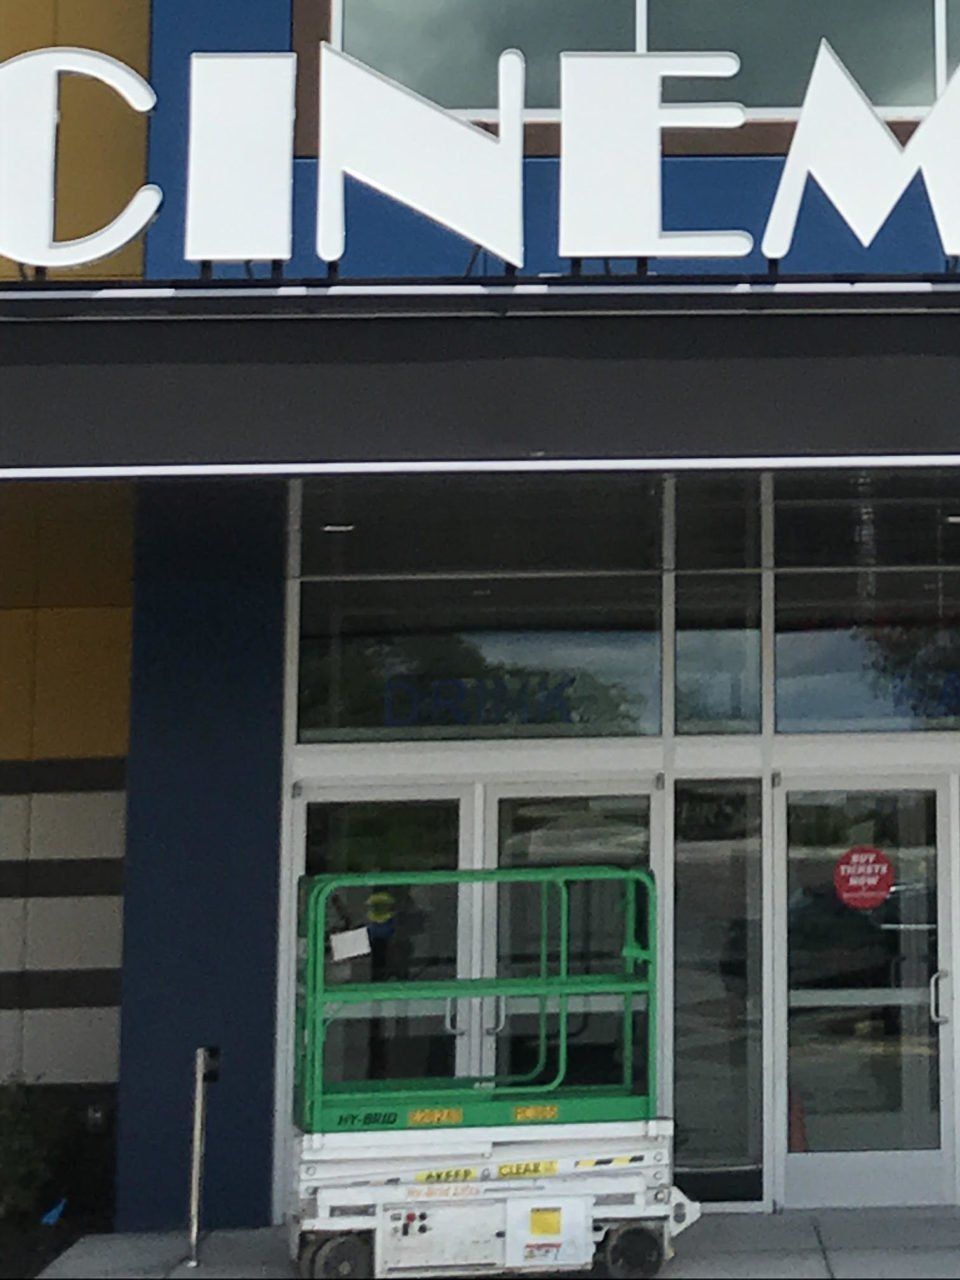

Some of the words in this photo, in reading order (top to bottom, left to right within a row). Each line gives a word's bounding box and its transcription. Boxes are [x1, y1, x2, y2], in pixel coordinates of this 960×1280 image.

[851, 853, 877, 864] BUY
[840, 864, 889, 875] TICKETS
[848, 875, 879, 886] NOW
[499, 1161, 541, 1176] CLEAR
